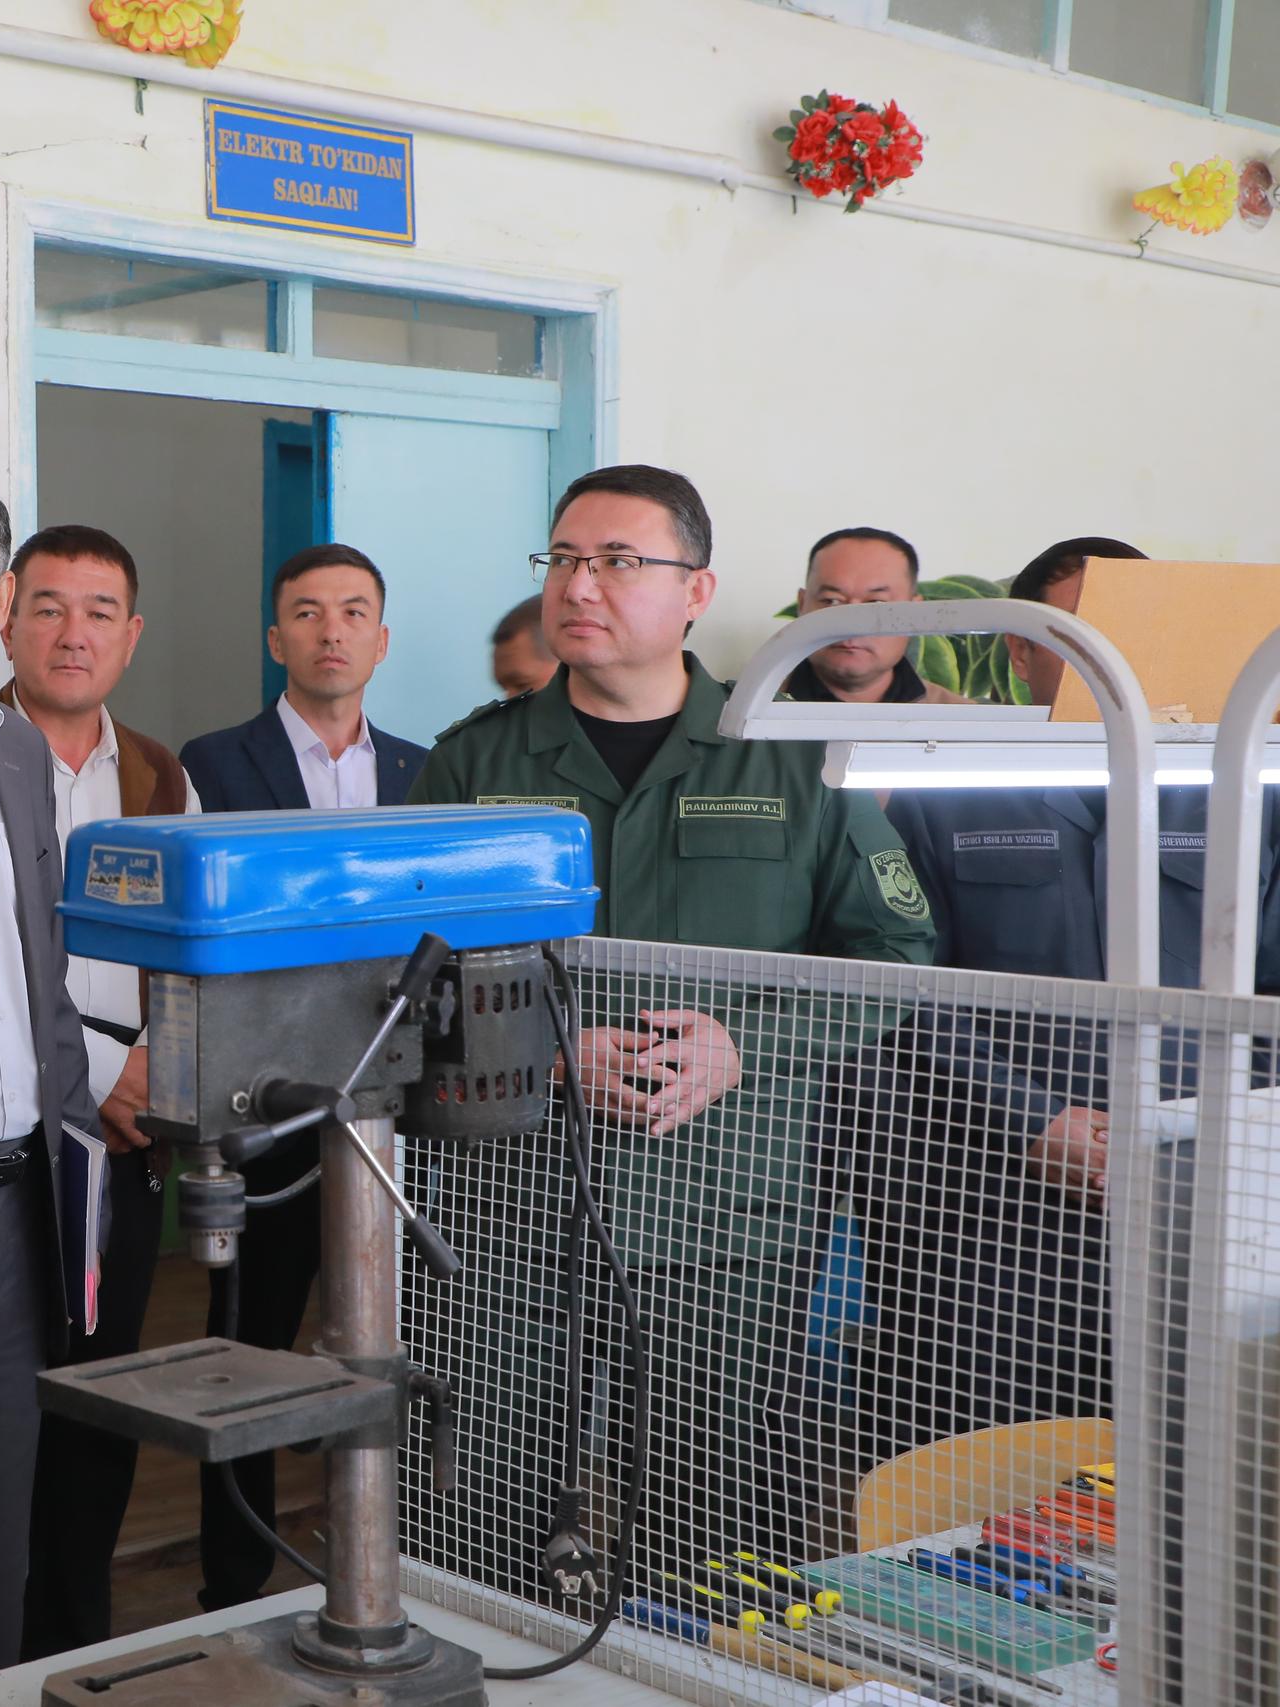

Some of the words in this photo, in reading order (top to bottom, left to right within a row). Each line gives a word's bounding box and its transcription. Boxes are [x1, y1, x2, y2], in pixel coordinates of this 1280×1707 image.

[218, 128, 304, 163] ELEKTR
[309, 143, 402, 179] TO'KIDAN
[273, 177, 358, 212] SAQLAN!
